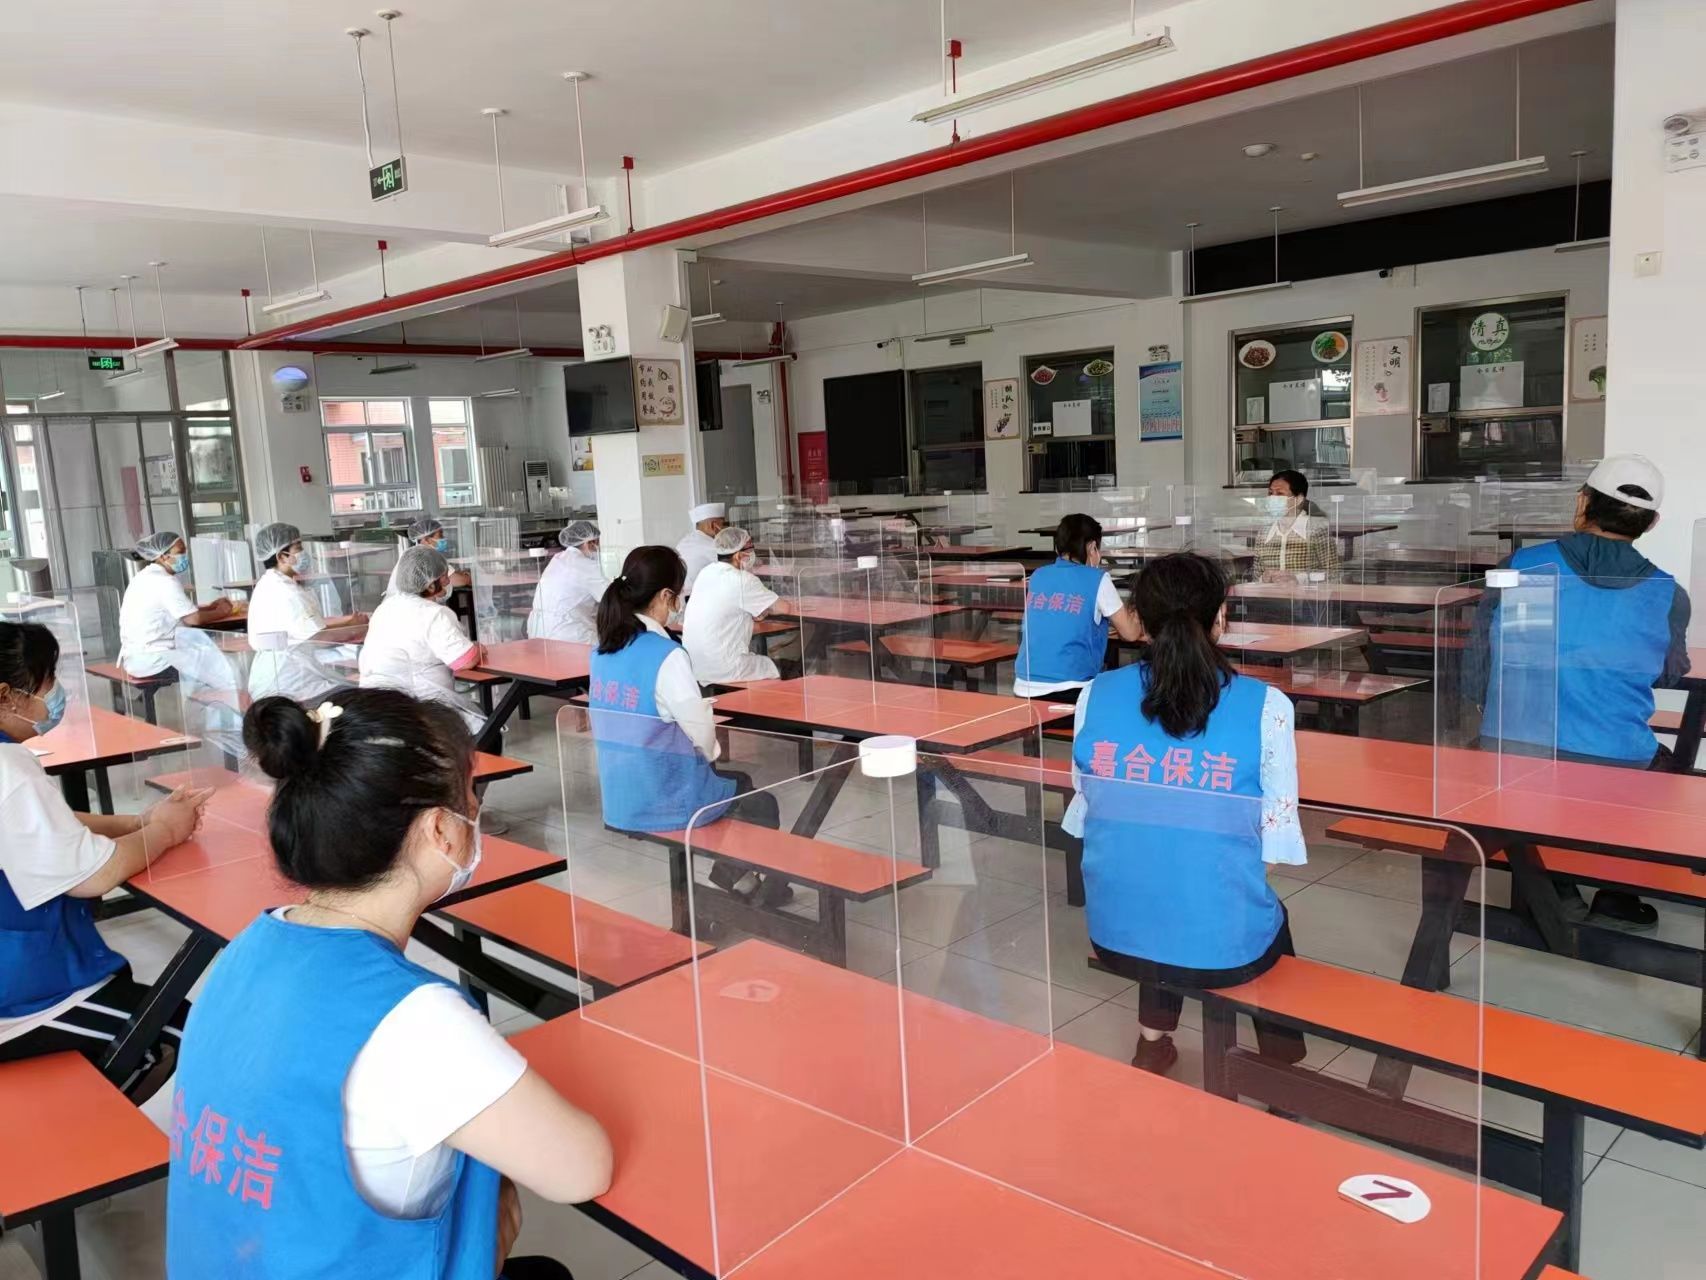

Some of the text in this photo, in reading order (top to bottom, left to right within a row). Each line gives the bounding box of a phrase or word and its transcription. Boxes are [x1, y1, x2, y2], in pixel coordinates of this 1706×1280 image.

[1472, 317, 1507, 336] 清真
[1389, 345, 1401, 368] 文明
[1089, 741, 1238, 791] 嘉合保洁
[1360, 1179, 1413, 1201] 7
